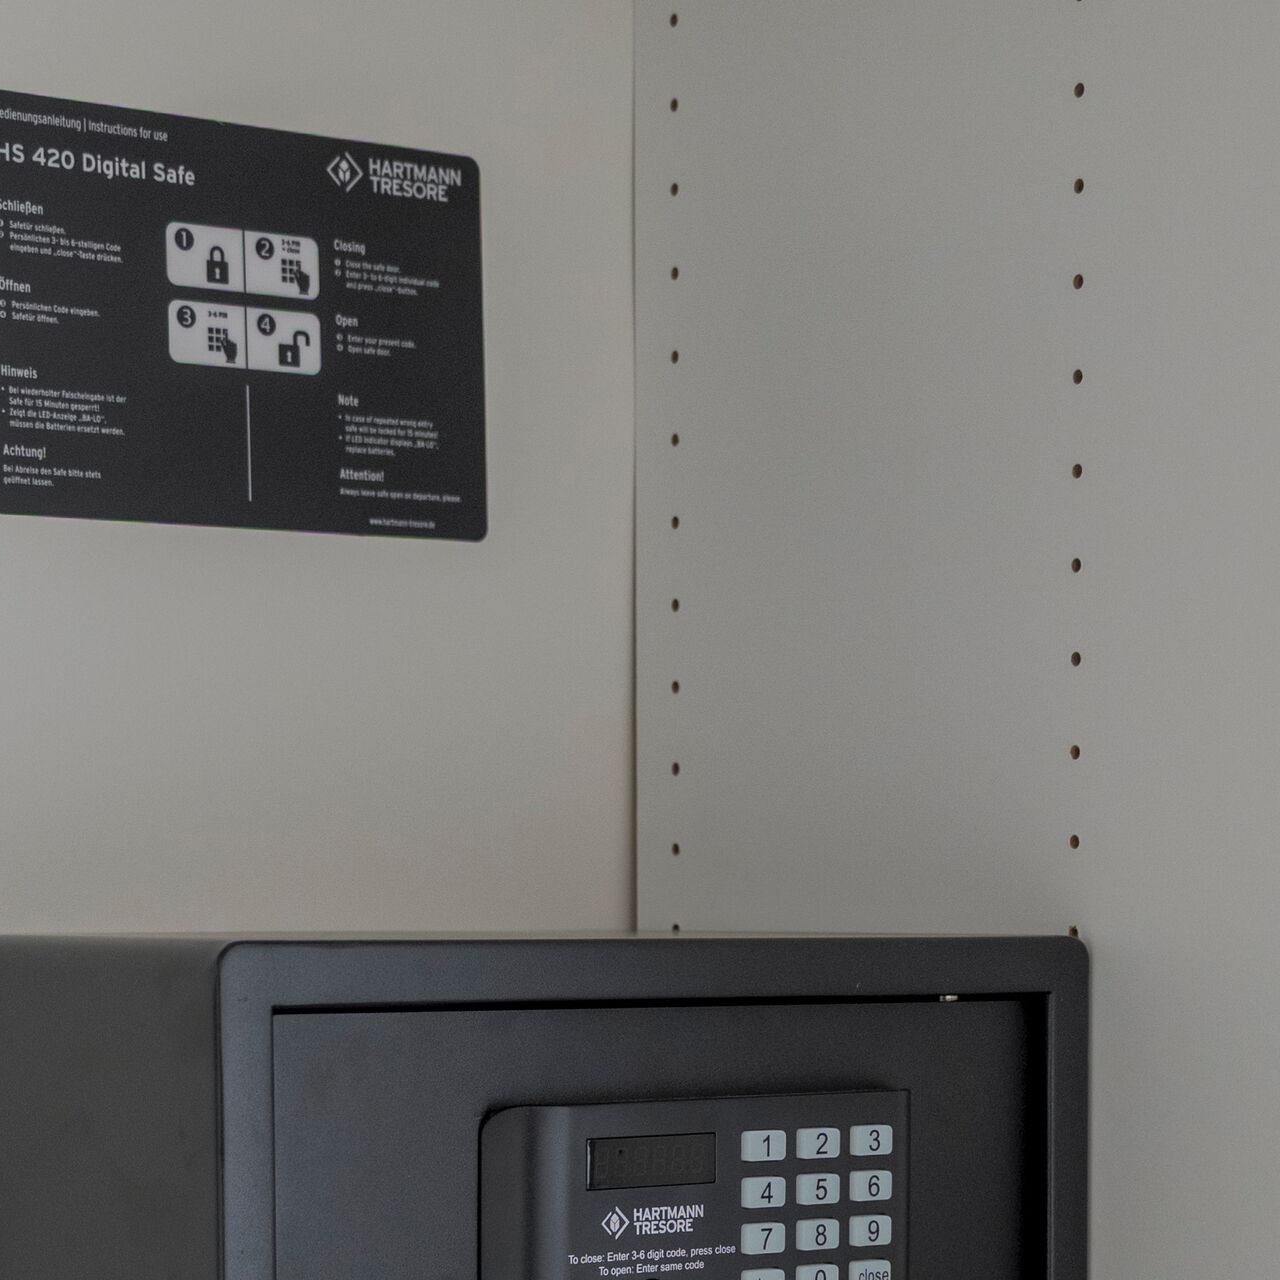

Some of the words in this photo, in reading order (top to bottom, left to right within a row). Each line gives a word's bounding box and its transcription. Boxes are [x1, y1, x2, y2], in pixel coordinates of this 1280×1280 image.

[88, 120, 138, 138] Instructions
[140, 127, 151, 139] for
[153, 130, 168, 142] use
[32, 147, 75, 170] 420
[82, 152, 146, 180] Digital
[153, 162, 196, 187] Safe
[369, 157, 462, 187] HARTMANN
[370, 176, 449, 203] TRESORE
[10, 220, 33, 231] Safetür
[10, 231, 50, 243] Persönlichen
[60, 238, 70, 246] bis
[71, 239, 104, 251] 6-stelligen
[106, 243, 121, 252] Code
[10, 243, 39, 254] eingeben
[40, 247, 52, 255] und
[333, 239, 366, 256] Closing
[12, 300, 52, 312] Persönlichen
[53, 305, 69, 314] Code
[12, 311, 35, 321] Safetür
[336, 314, 358, 328] Open
[1, 364, 38, 379] Hinweis
[9, 385, 19, 394] Bei
[20, 386, 60, 398] wiederholter
[61, 390, 105, 402] Falscheingabe
[106, 394, 115, 403] ist
[116, 395, 127, 403] der
[338, 394, 359, 407] Note
[9, 397, 23, 406] Safe
[25, 398, 34, 407] für
[36, 399, 42, 407] 15
[44, 400, 69, 409] Minuten
[9, 408, 25, 419] Zeigt
[27, 410, 37, 418] die
[38, 410, 77, 422] LED-Anzeige
[9, 419, 33, 429] müssen
[35, 421, 45, 430] die
[46, 421, 76, 432] Batterien
[77, 425, 100, 434] ersetzt
[3, 443, 47, 460] Achtung!
[3, 464, 13, 473] Bei
[15, 465, 39, 475] Abreise
[40, 466, 52, 475] den
[53, 467, 67, 477] Safe
[68, 468, 83, 478] bitte
[85, 470, 101, 479] stets
[3, 475, 30, 485] geöffnet
[340, 468, 384, 482] Attention!
[762, 1134, 771, 1157] 1
[816, 1132, 828, 1155] 2
[868, 1129, 881, 1151] 3
[761, 1181, 773, 1204] 4
[815, 1178, 828, 1200] 5
[868, 1175, 880, 1197] 6
[633, 1204, 704, 1222] HARTMANN
[634, 1219, 694, 1235] TRESORE
[815, 1223, 827, 1246] 8
[868, 1220, 880, 1242] 9
[761, 1227, 773, 1250] 7
[568, 1255, 579, 1265] To
[580, 1252, 605, 1264] close:
[607, 1251, 629, 1262] Enter
[631, 1250, 645, 1260] 3-6
[647, 1248, 664, 1261] digit
[666, 1247, 688, 1258] code,
[690, 1246, 713, 1257] press
[714, 1244, 736, 1255] close
[598, 1266, 609, 1276] To
[610, 1265, 634, 1277] open:
[636, 1263, 659, 1274] Enter
[660, 1262, 682, 1272] same
[684, 1260, 705, 1271] code
